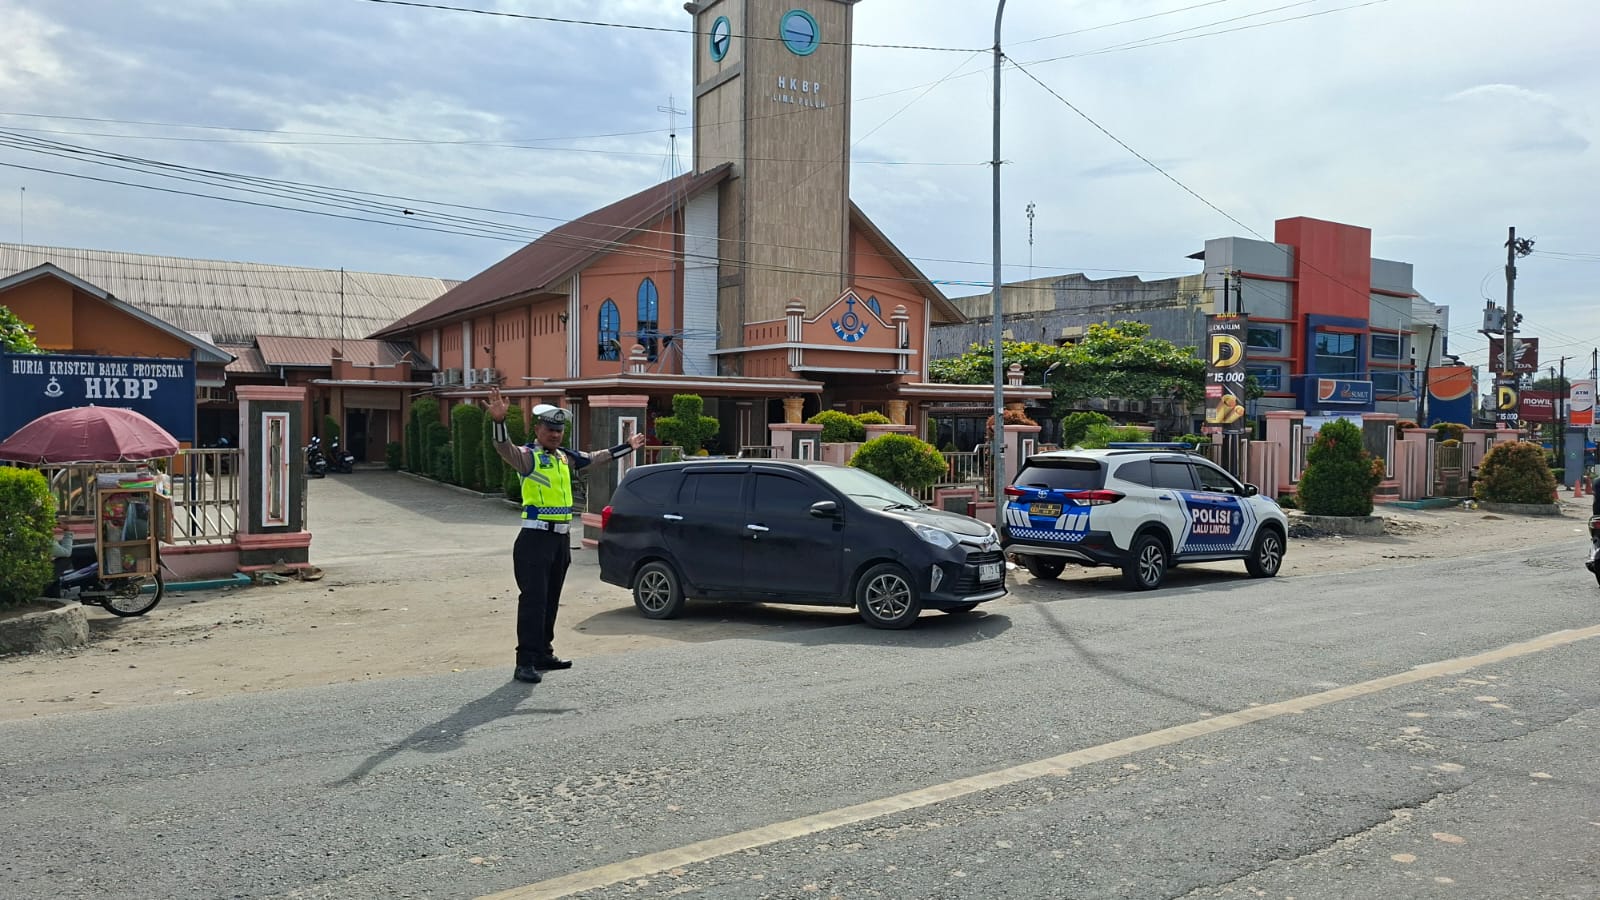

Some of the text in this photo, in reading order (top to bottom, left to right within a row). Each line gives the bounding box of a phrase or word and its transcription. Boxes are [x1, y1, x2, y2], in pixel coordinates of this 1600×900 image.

[778, 76, 819, 93] HKBP
[835, 325, 865, 341] HKBP
[12, 360, 184, 378] HURIA KRISTEN BATAK PROTESTAN
[1214, 372, 1245, 382] 15.000
[84, 378, 158, 399] HKBP
[1192, 509, 1230, 524] POLISI
[1193, 524, 1230, 534] LALU LINTAS
